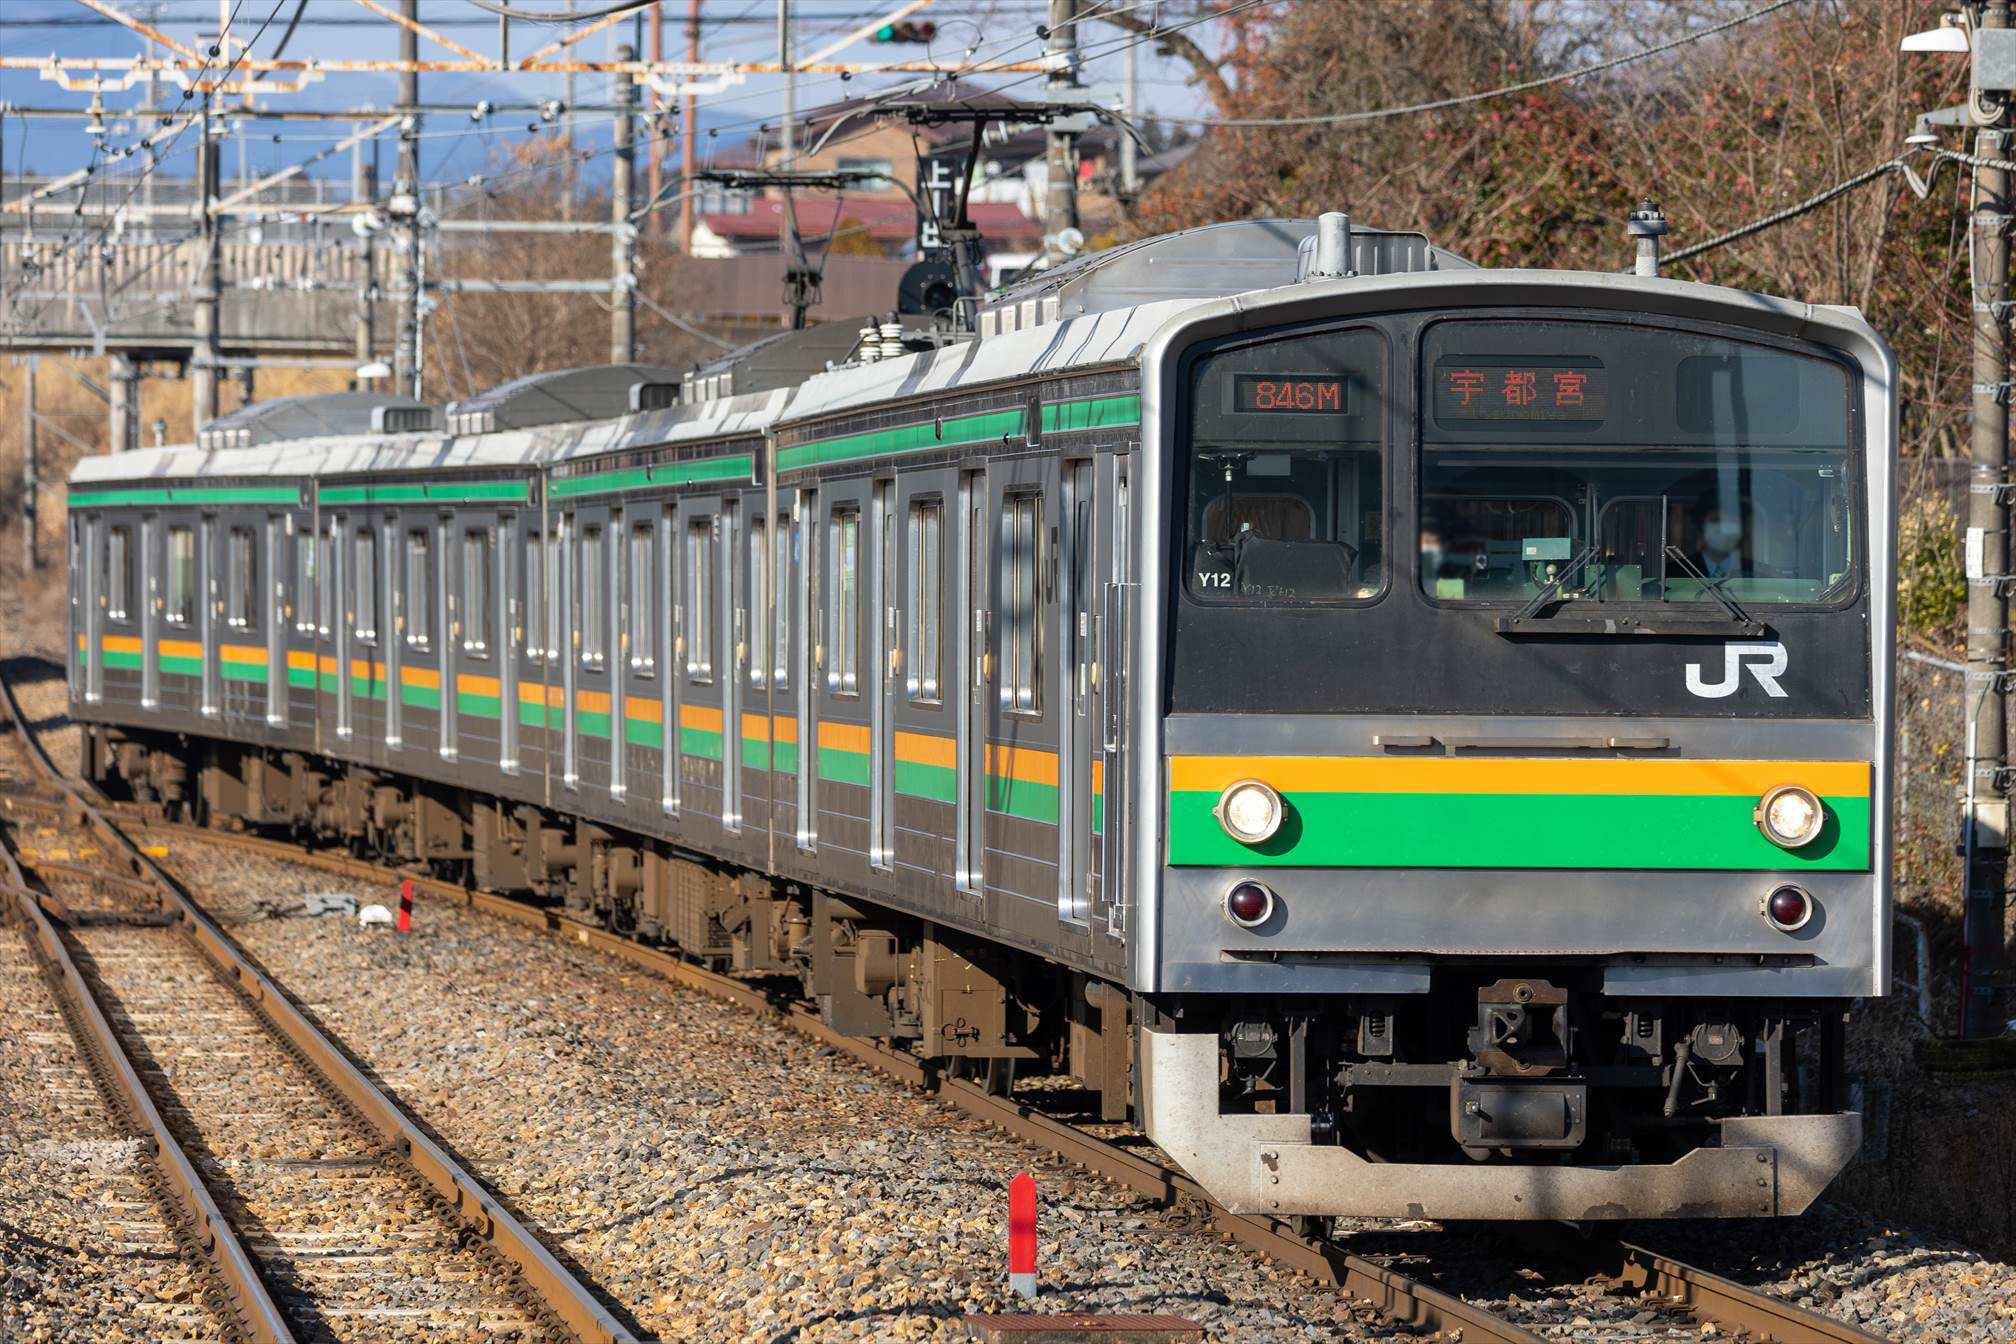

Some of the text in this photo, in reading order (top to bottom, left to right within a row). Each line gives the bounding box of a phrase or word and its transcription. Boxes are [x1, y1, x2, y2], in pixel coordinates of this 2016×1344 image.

[1256, 381, 1340, 410] 846M
[1450, 369, 1587, 406] 宇都宮
[1199, 572, 1232, 588] Y12
[1685, 641, 1790, 699] JR
